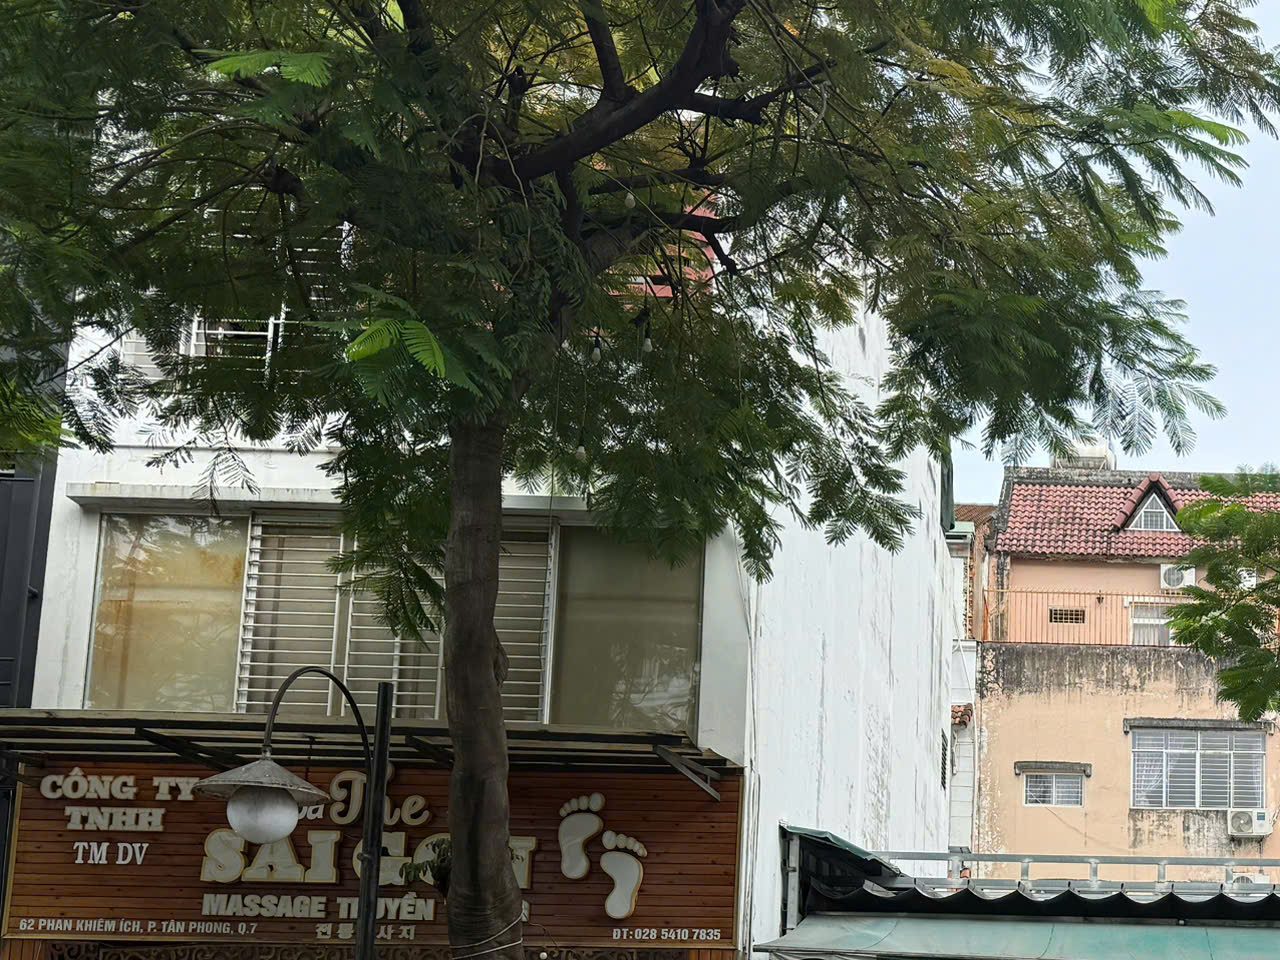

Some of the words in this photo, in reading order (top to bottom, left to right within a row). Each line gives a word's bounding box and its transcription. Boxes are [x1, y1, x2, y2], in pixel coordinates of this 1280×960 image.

[40, 767, 138, 799] CÔNG
[152, 777, 200, 800] TY
[64, 806, 166, 831] TNHH
[73, 842, 108, 865] TM
[115, 843, 149, 865] DV
[201, 828, 341, 884] SAI
[202, 893, 328, 918] MASSAGE
[19, 918, 35, 931] 62
[38, 919, 73, 932] PHAN
[76, 917, 116, 933] KHIÊM
[147, 921, 158, 932] P.
[161, 919, 187, 933] TÂN
[188, 921, 235, 935] PHONG,
[237, 922, 258, 935] Q.7
[634, 928, 657, 940] 028
[660, 929, 689, 941] 5410
[691, 929, 721, 941] 7835
